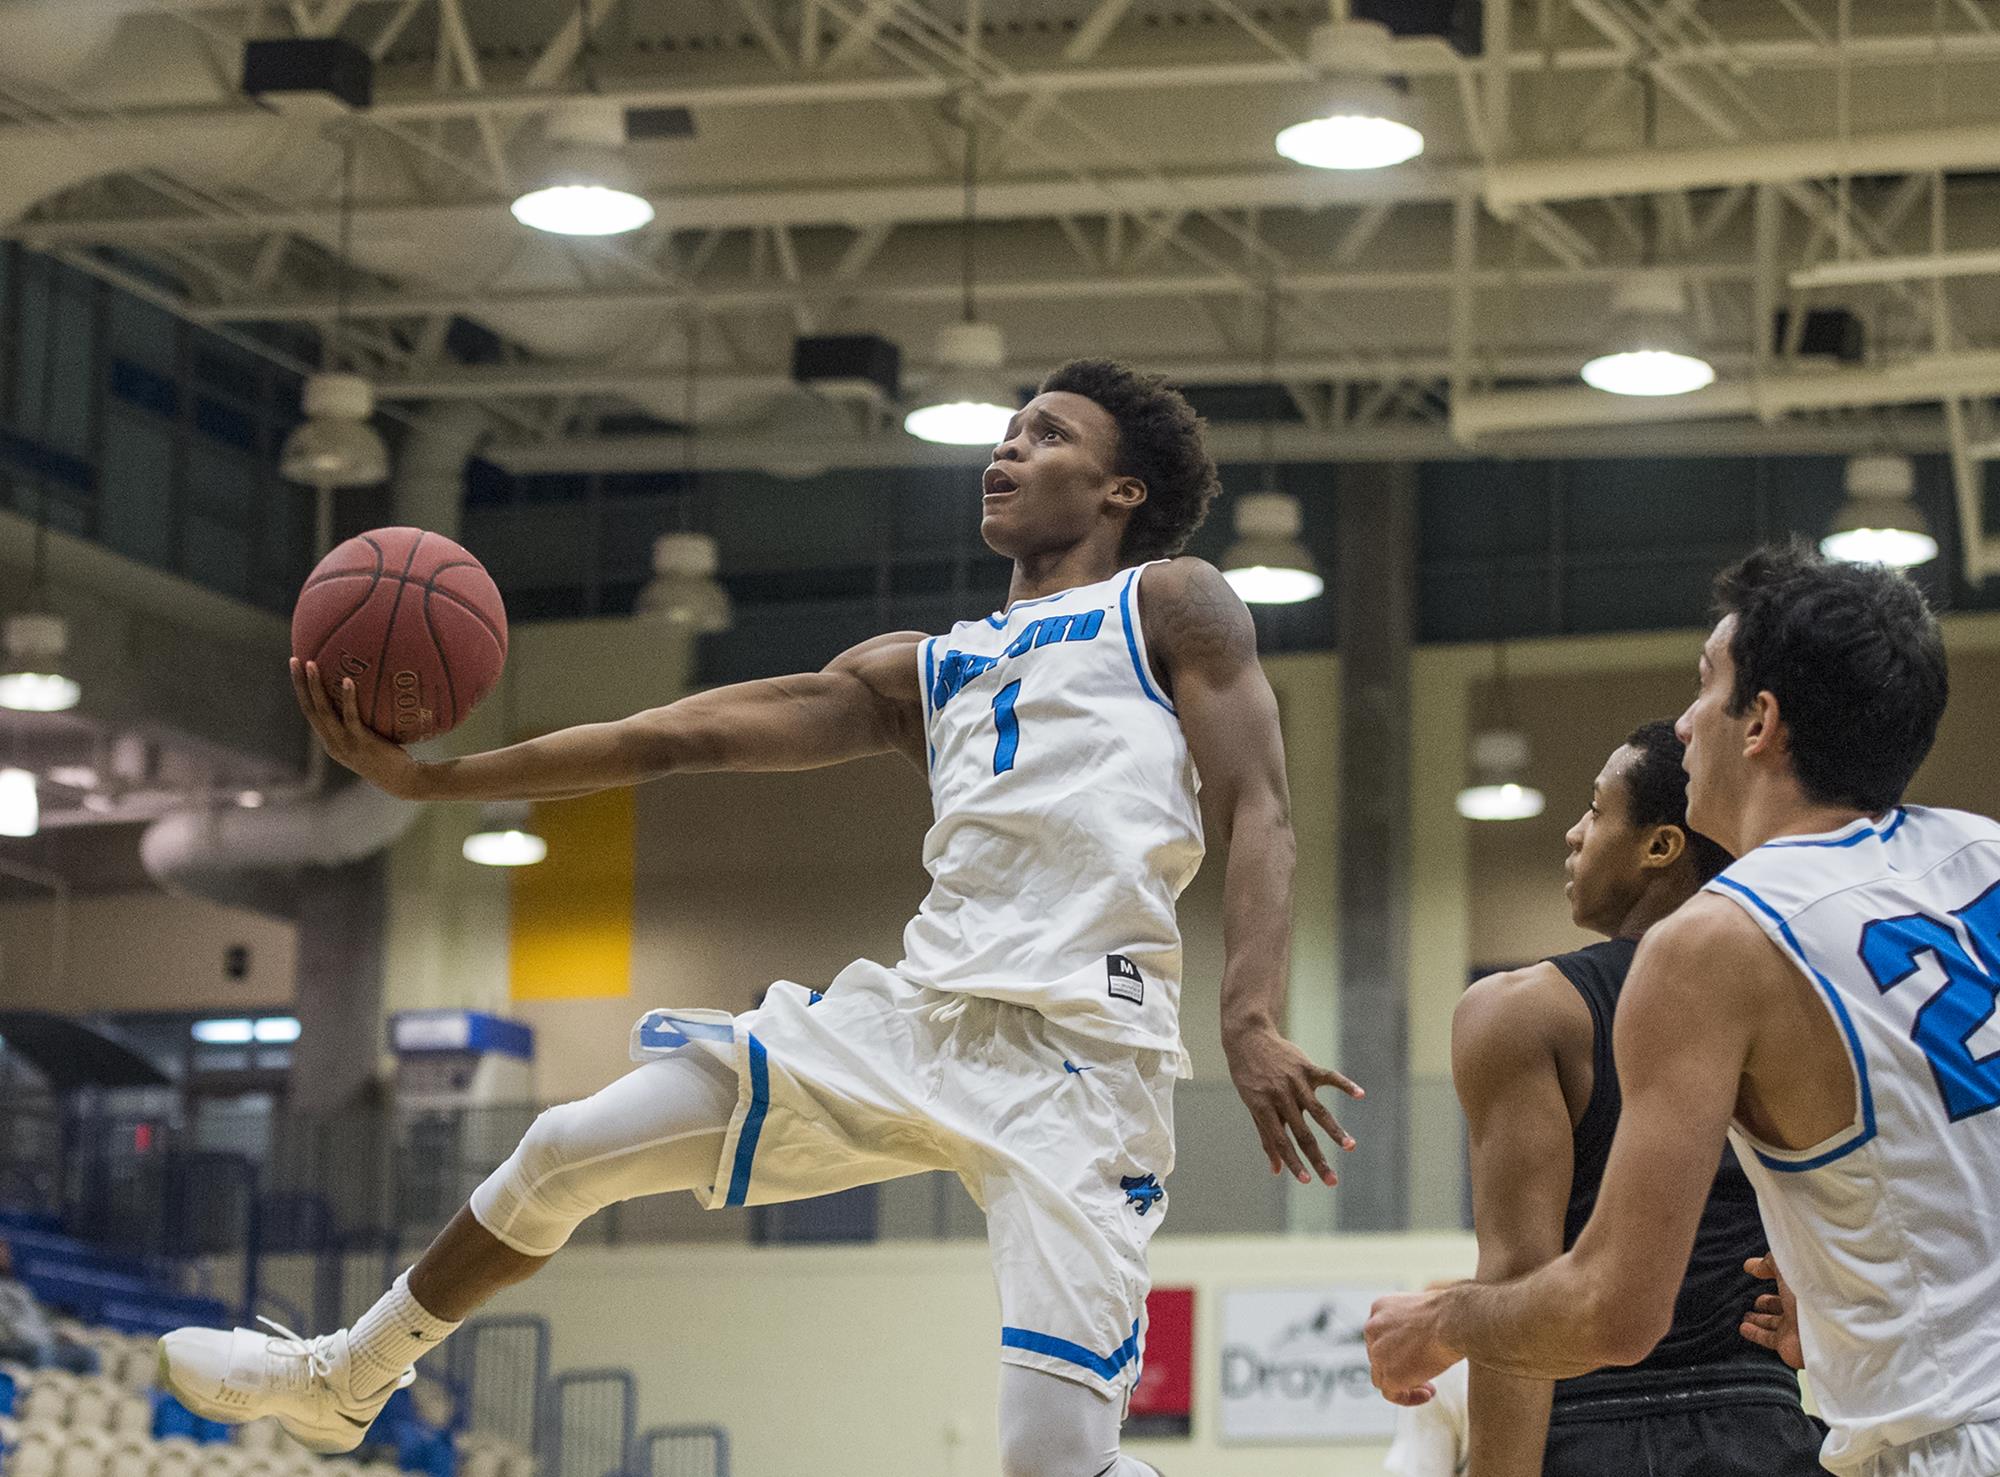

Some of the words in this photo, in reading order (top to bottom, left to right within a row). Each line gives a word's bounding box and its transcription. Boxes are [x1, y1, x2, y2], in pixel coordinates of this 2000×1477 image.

[991, 678, 1022, 776] 1
[1120, 960, 1134, 975] M
[1221, 1344, 1373, 1413] Draye
